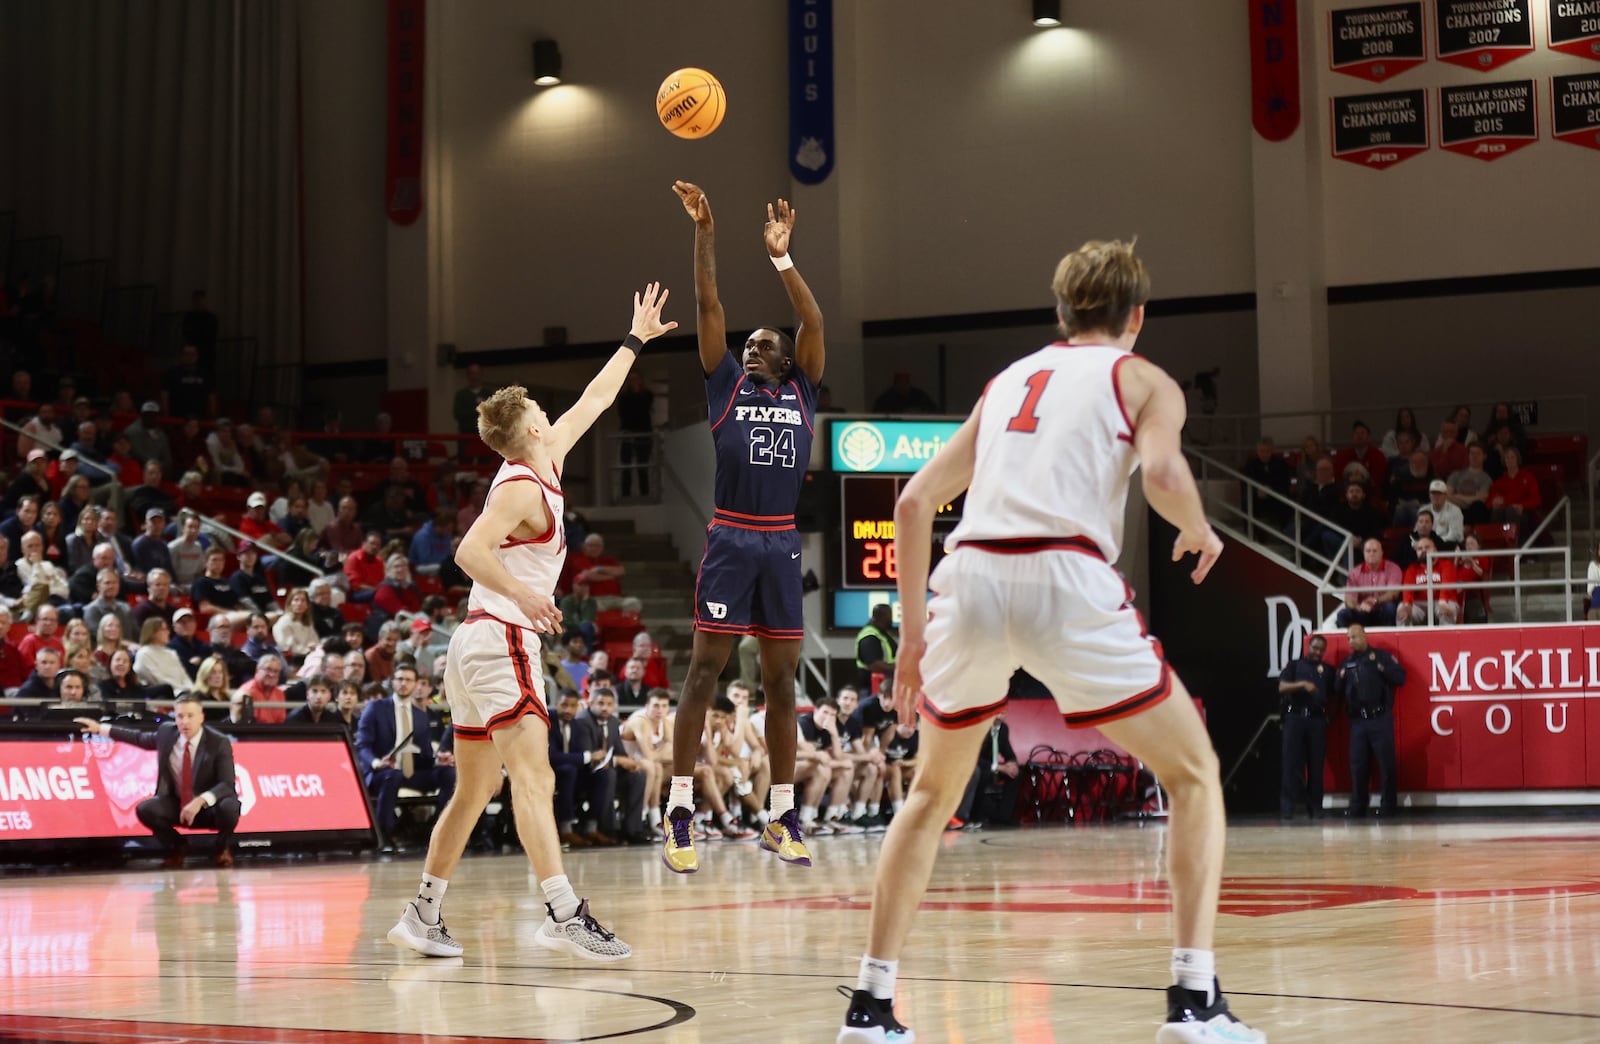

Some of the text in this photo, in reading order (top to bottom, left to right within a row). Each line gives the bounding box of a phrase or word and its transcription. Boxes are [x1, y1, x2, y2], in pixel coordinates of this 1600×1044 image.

[1451, 0, 1516, 13] TOURNAMENT
[1345, 9, 1409, 25] TOURNAMENT
[1445, 8, 1522, 29] CHAMPIONS
[1340, 20, 1414, 40] CHAMPIONS
[1468, 28, 1501, 44] 2007
[803, 0, 819, 102] OUIS
[1362, 40, 1394, 55] 2008
[1448, 87, 1528, 103] REGULAR SEASON
[662, 95, 698, 124] Wilson
[1347, 98, 1412, 113] TOURNAMENT
[1450, 98, 1526, 118] CHAMPIONS
[1342, 110, 1417, 129] CHAMPIONS
[1474, 118, 1504, 133] 2015
[1006, 369, 1054, 433] 1
[735, 406, 802, 426] FLYERS
[750, 426, 796, 468] 24
[893, 434, 947, 459] Atri
[257, 773, 325, 798] INFLCR
